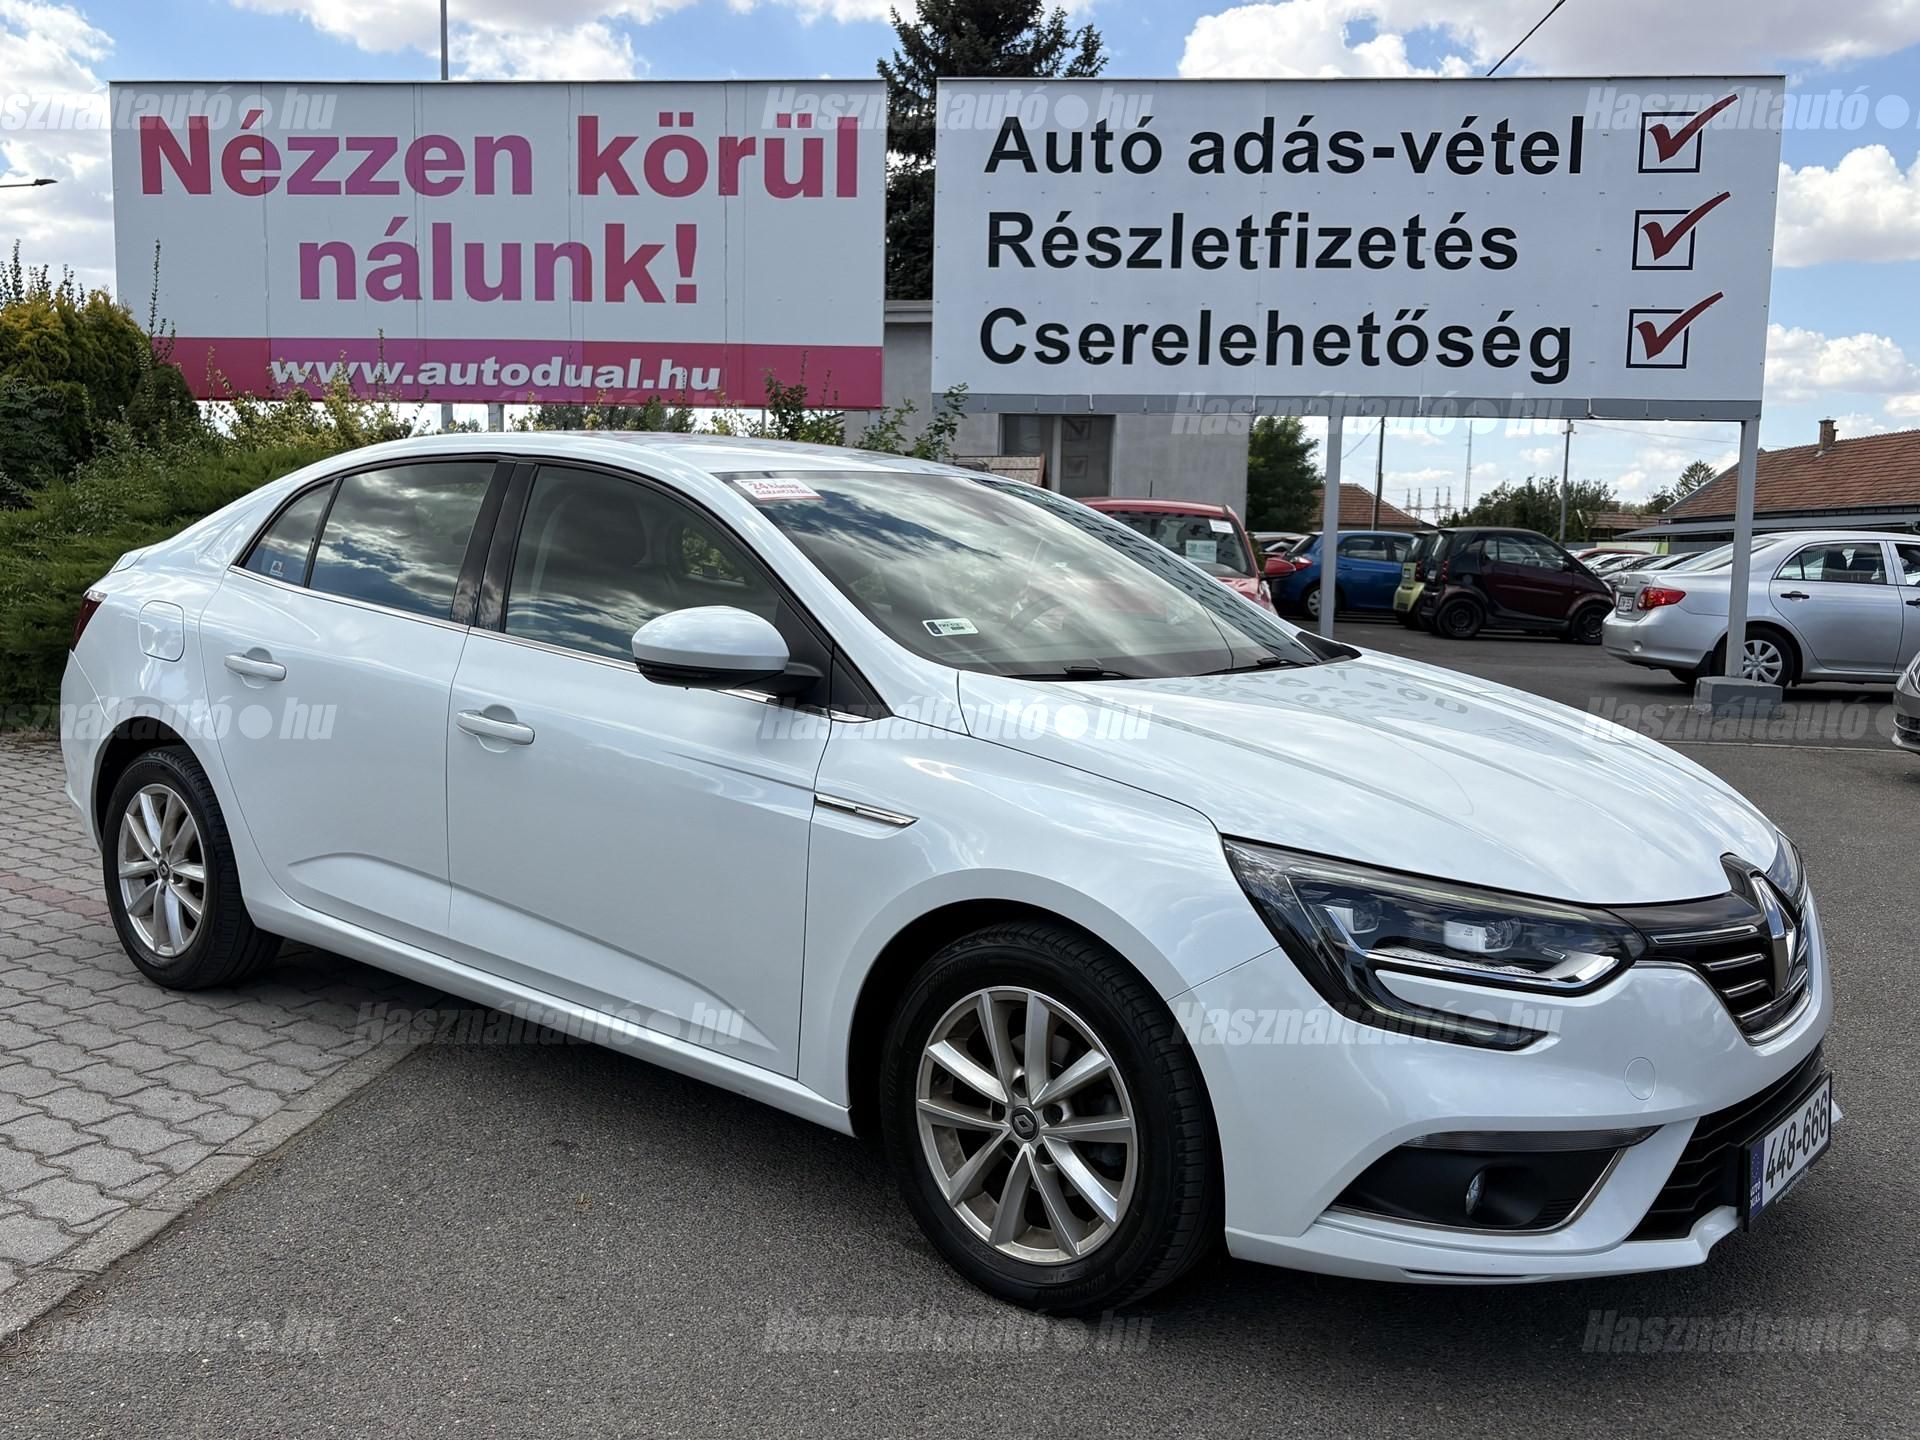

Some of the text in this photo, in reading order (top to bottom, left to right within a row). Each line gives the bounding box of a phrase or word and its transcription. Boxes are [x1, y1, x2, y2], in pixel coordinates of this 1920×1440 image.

[140, 110, 858, 198] Nézzen körül
[985, 115, 1583, 176] Autó adás-vétel
[300, 217, 698, 304] nálunk!
[987, 210, 1518, 270] Részletfizetés
[270, 355, 721, 391] www.autodual.hu
[980, 308, 1572, 385] Cserelehetőség
[1765, 1090, 1828, 1190] 448-666
